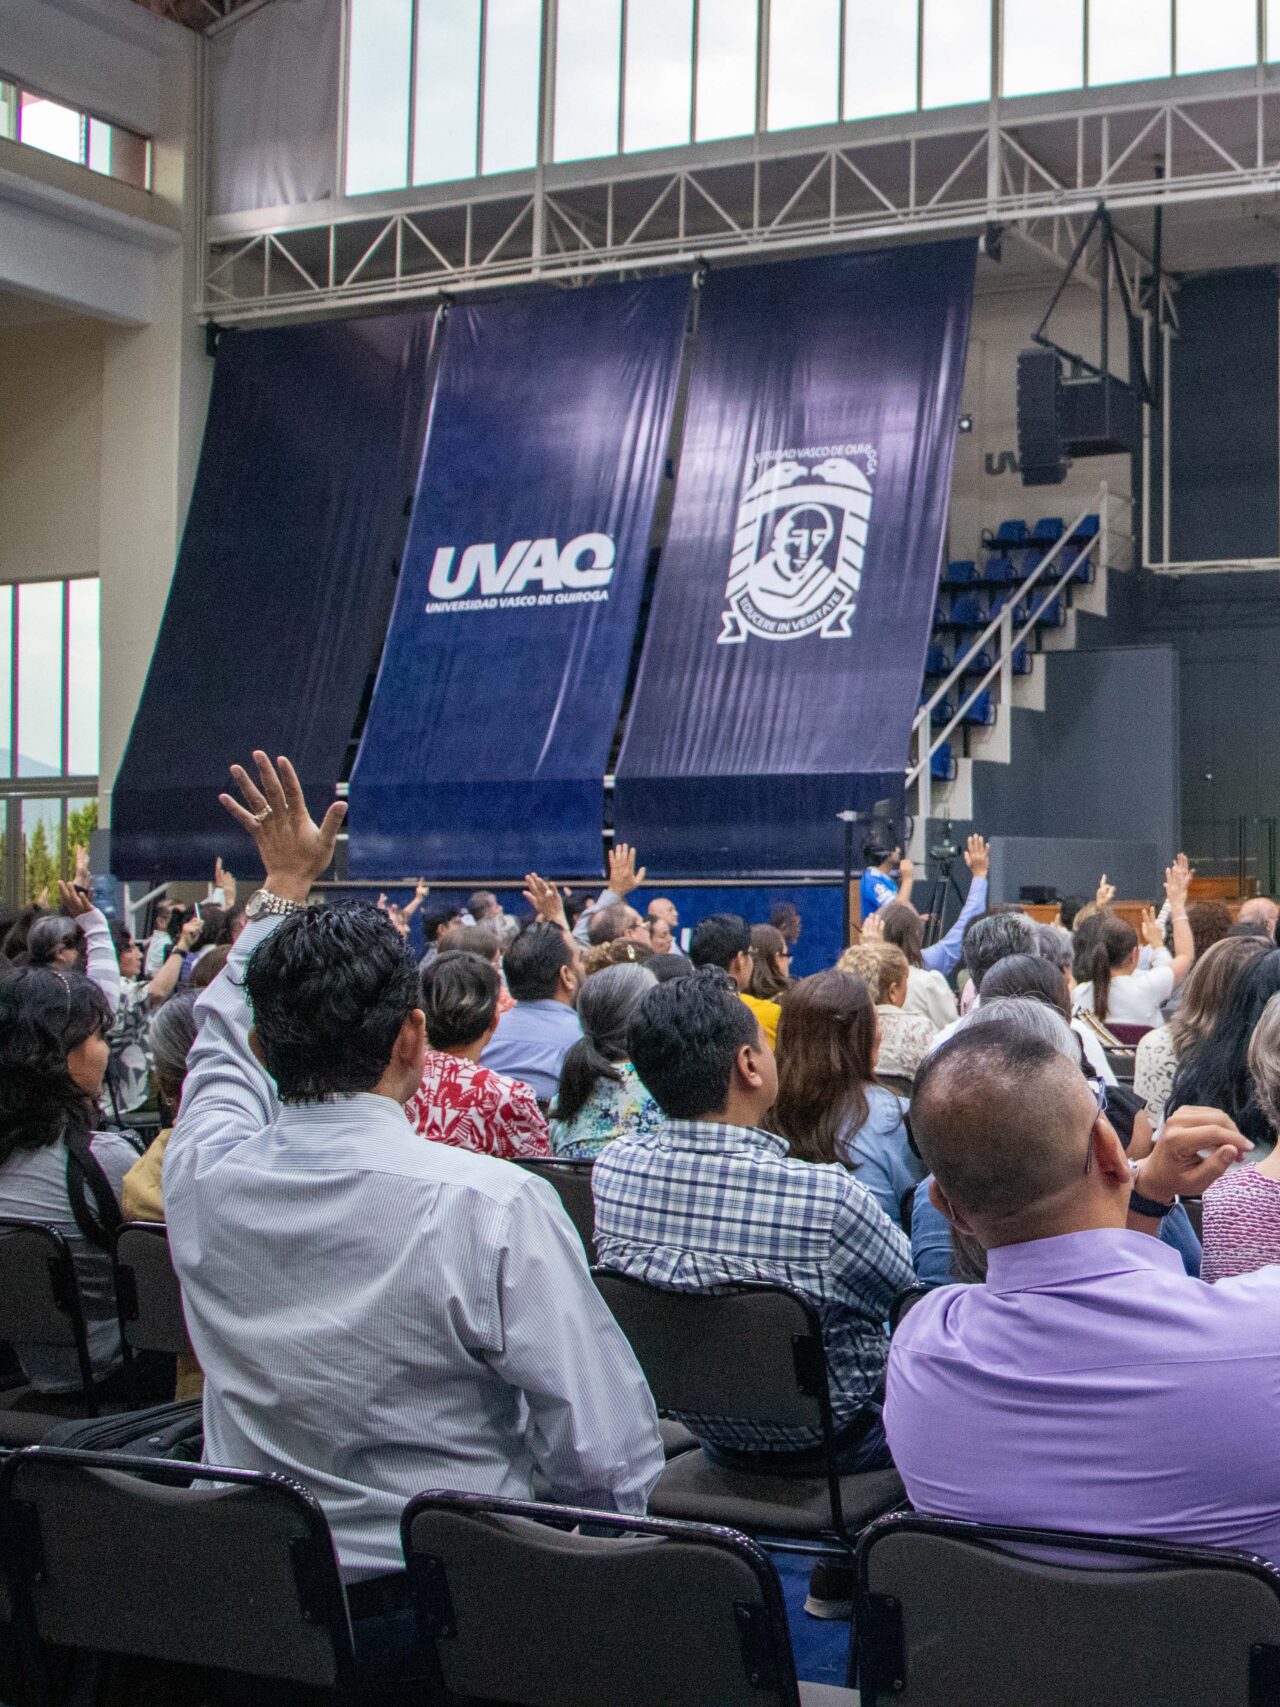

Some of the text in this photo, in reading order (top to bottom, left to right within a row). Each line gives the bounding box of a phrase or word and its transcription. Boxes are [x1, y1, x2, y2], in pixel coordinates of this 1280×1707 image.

[797, 446, 829, 460] VASCO
[830, 445, 844, 457] DE
[428, 532, 616, 600] UVAQ
[425, 590, 609, 614] UNIVERSIDAD VASCO DE QUIROGA
[739, 592, 841, 632] EDUCERE IN VERITATE
